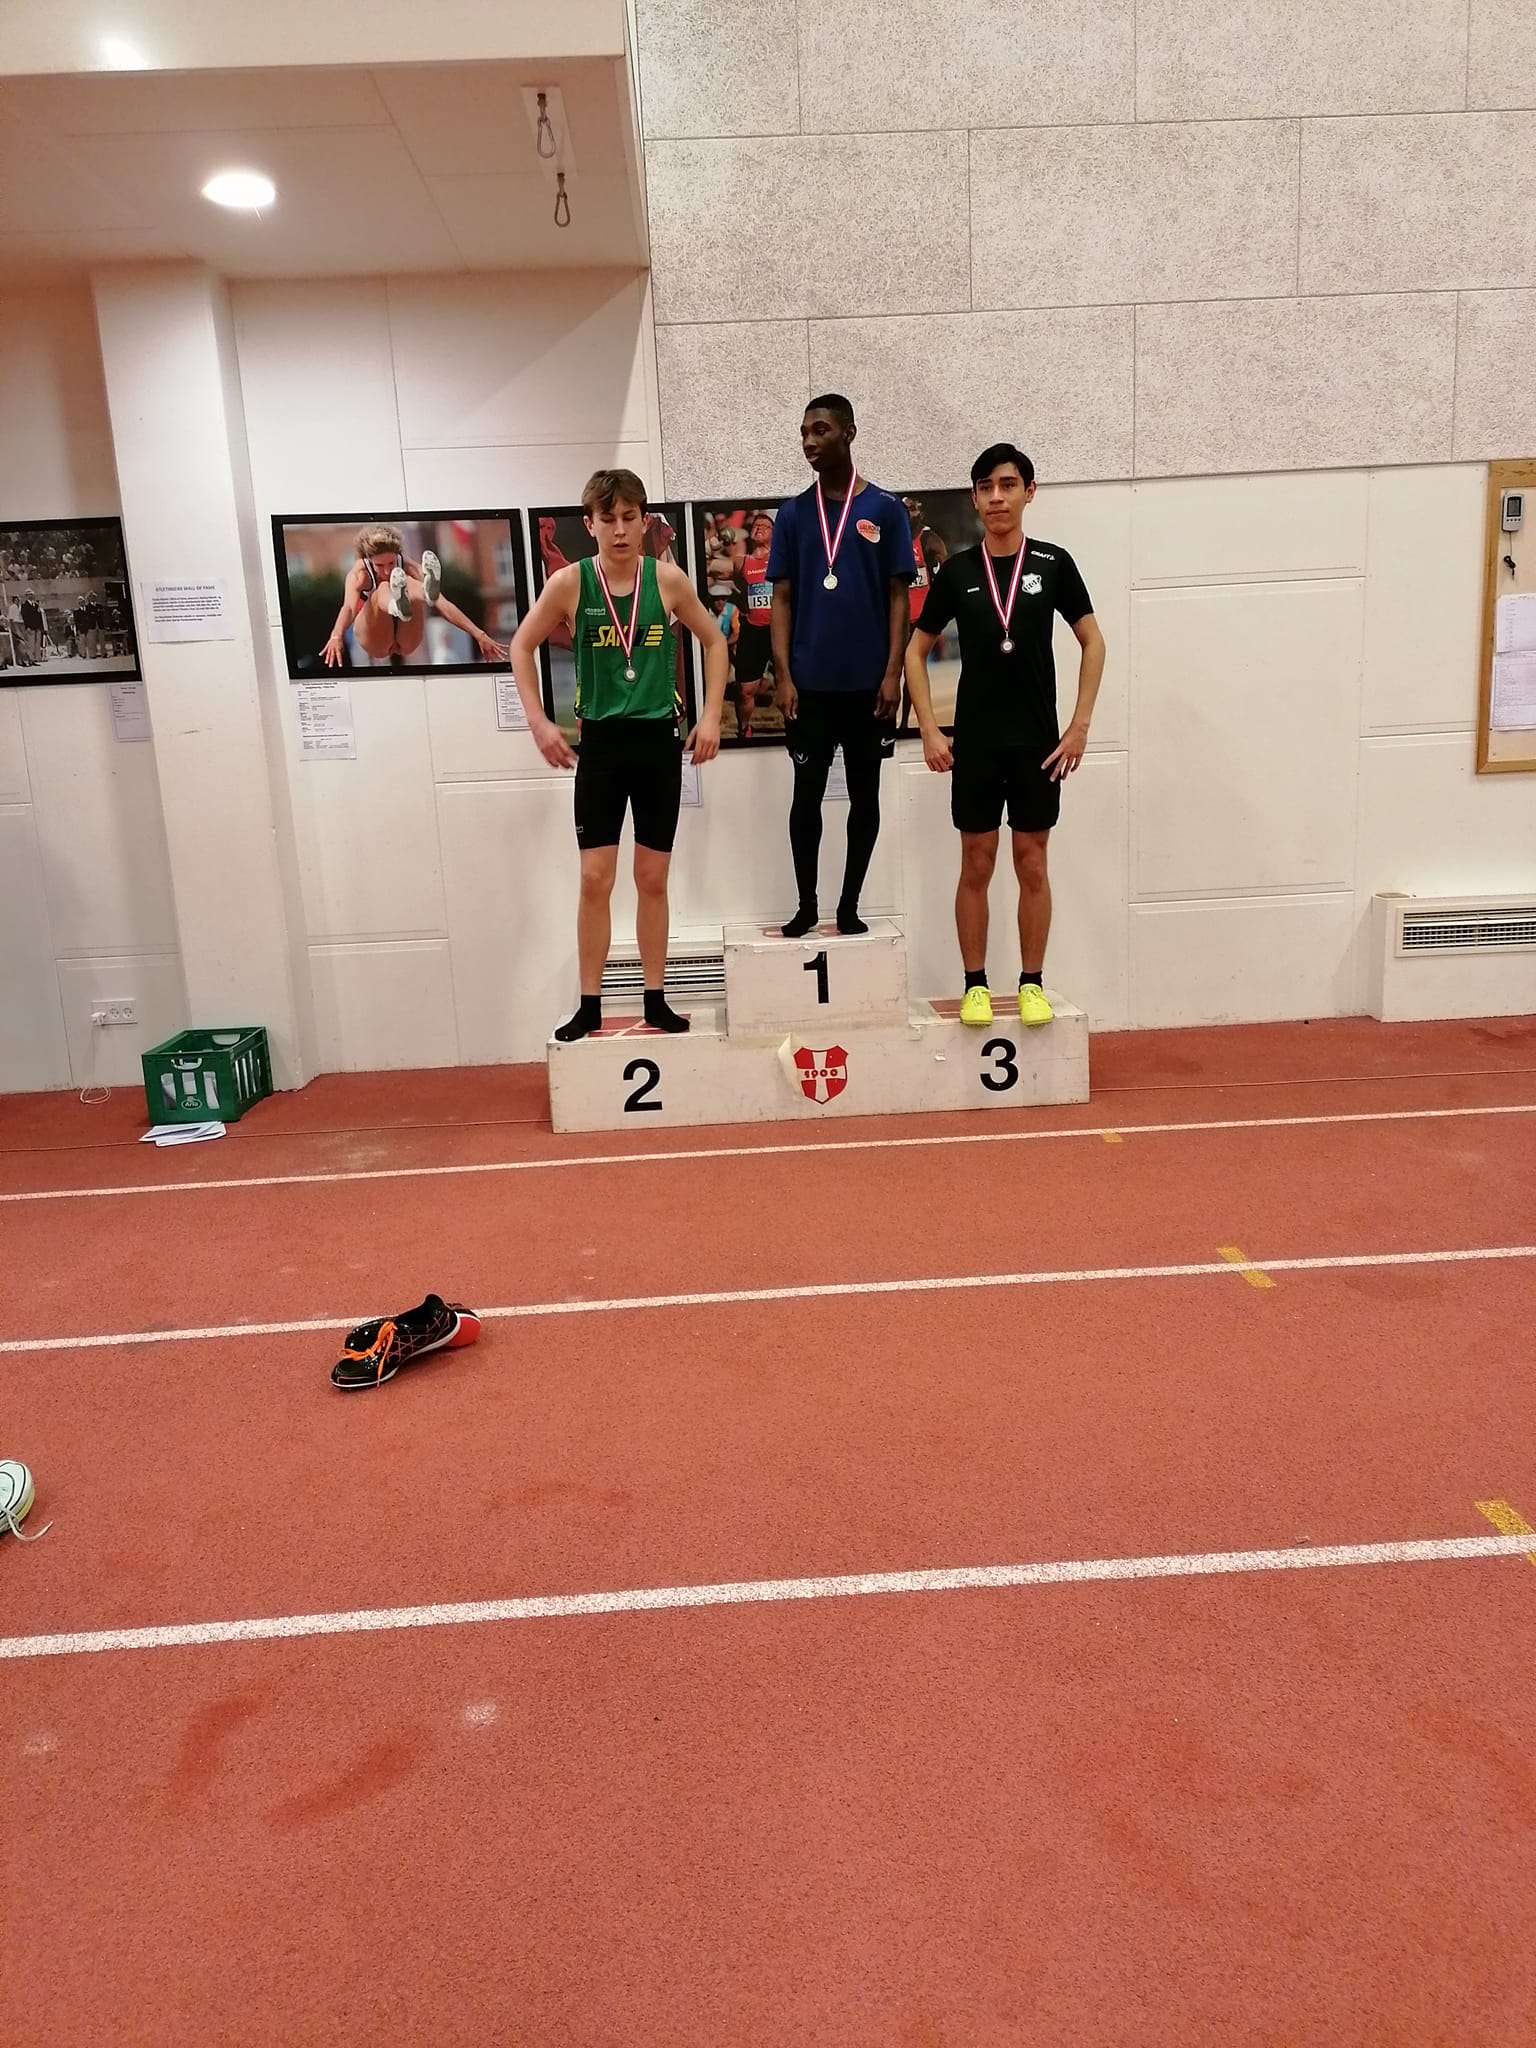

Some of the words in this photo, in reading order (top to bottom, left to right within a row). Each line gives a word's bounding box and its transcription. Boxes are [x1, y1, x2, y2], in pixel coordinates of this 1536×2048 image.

[804, 951, 829, 1004] 1
[623, 1058, 663, 1113] 2
[804, 1069, 838, 1079] 1900
[980, 1037, 1019, 1092] 3
